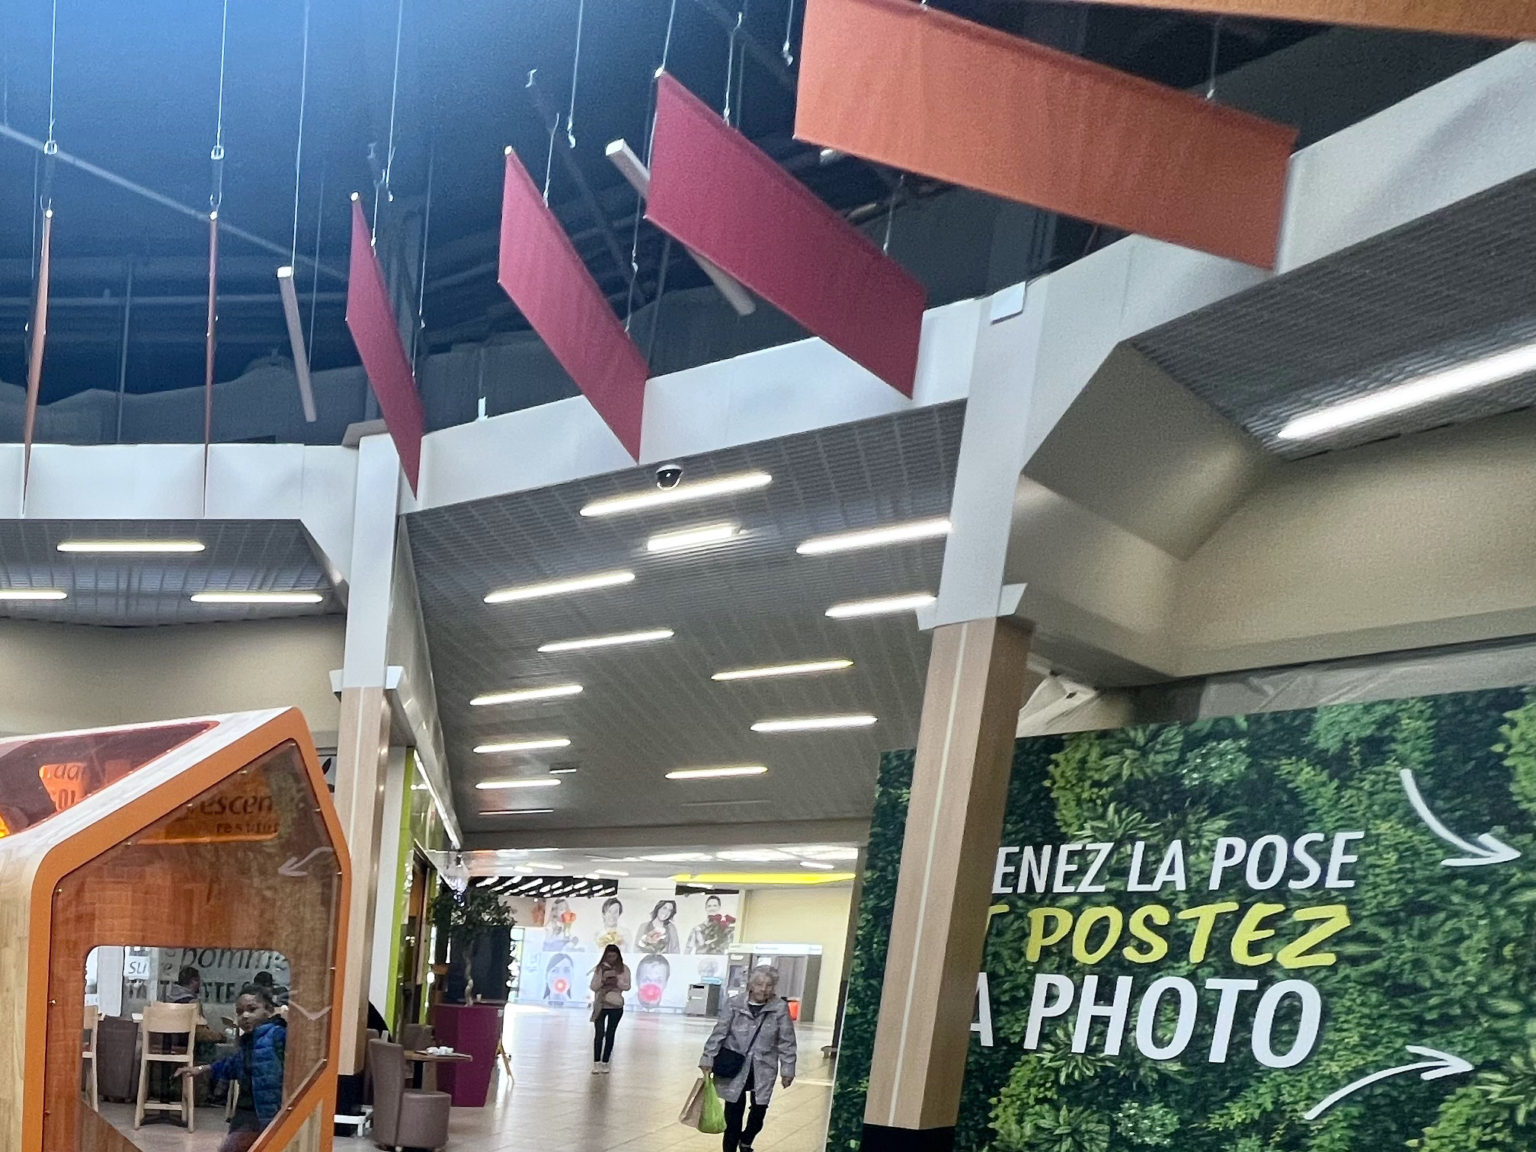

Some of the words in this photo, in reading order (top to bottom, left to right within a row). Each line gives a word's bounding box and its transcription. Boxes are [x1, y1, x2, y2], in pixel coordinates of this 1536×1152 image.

[1126, 839, 1187, 893] LA
[1208, 831, 1365, 891] POSE
[1024, 901, 1352, 970] POSTEZ
[1023, 972, 1323, 1069] PHOTO
